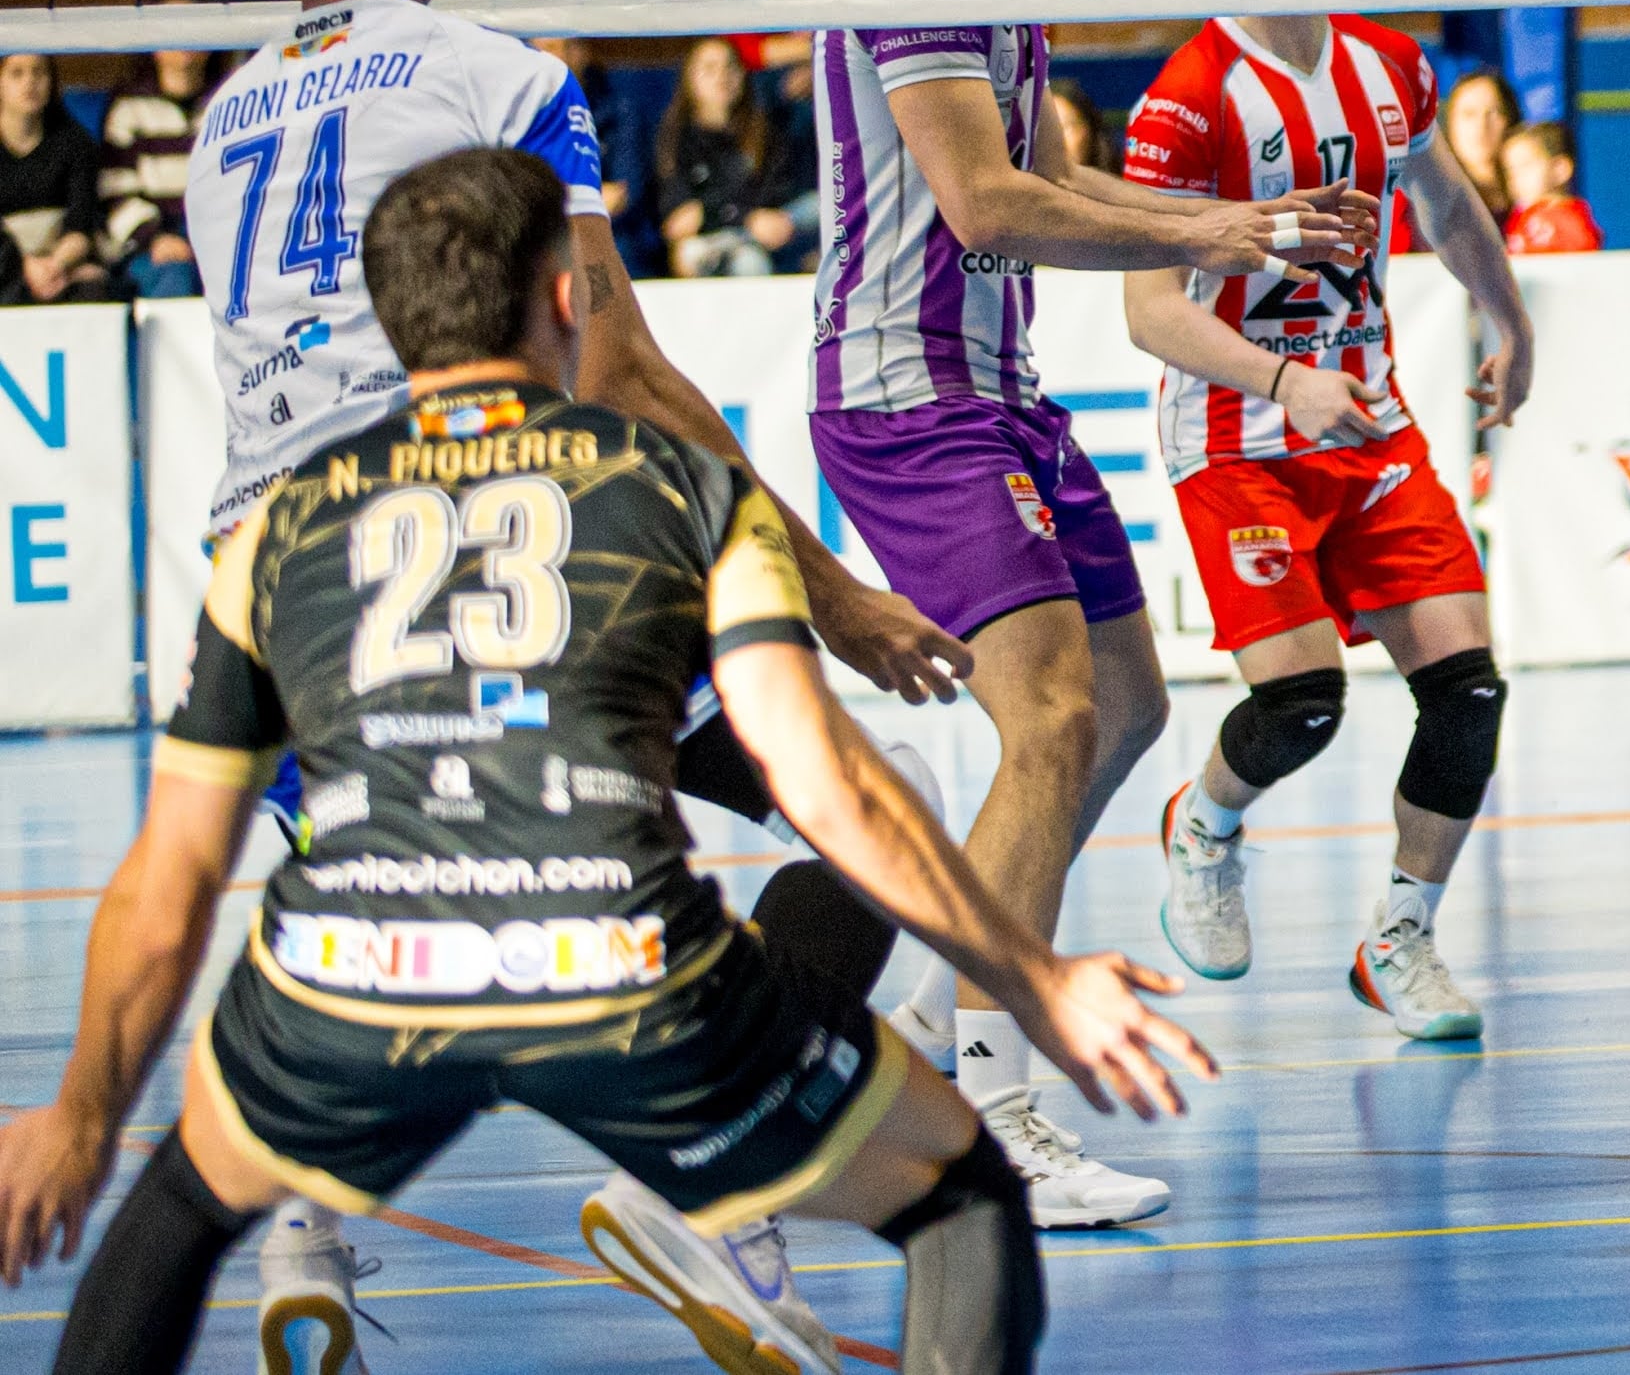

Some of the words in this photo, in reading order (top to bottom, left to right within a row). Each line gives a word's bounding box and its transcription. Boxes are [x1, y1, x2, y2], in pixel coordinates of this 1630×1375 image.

[880, 30, 957, 53] CHALLENGE
[202, 81, 288, 147] VIDONI
[296, 53, 424, 111] GELARDI
[1138, 141, 1171, 163] CEV
[1317, 133, 1356, 187] 17
[220, 107, 358, 325] 74
[238, 343, 304, 397] suma
[390, 429, 599, 483] PIQUERES
[12, 503, 69, 603] E
[347, 473, 574, 695] 23
